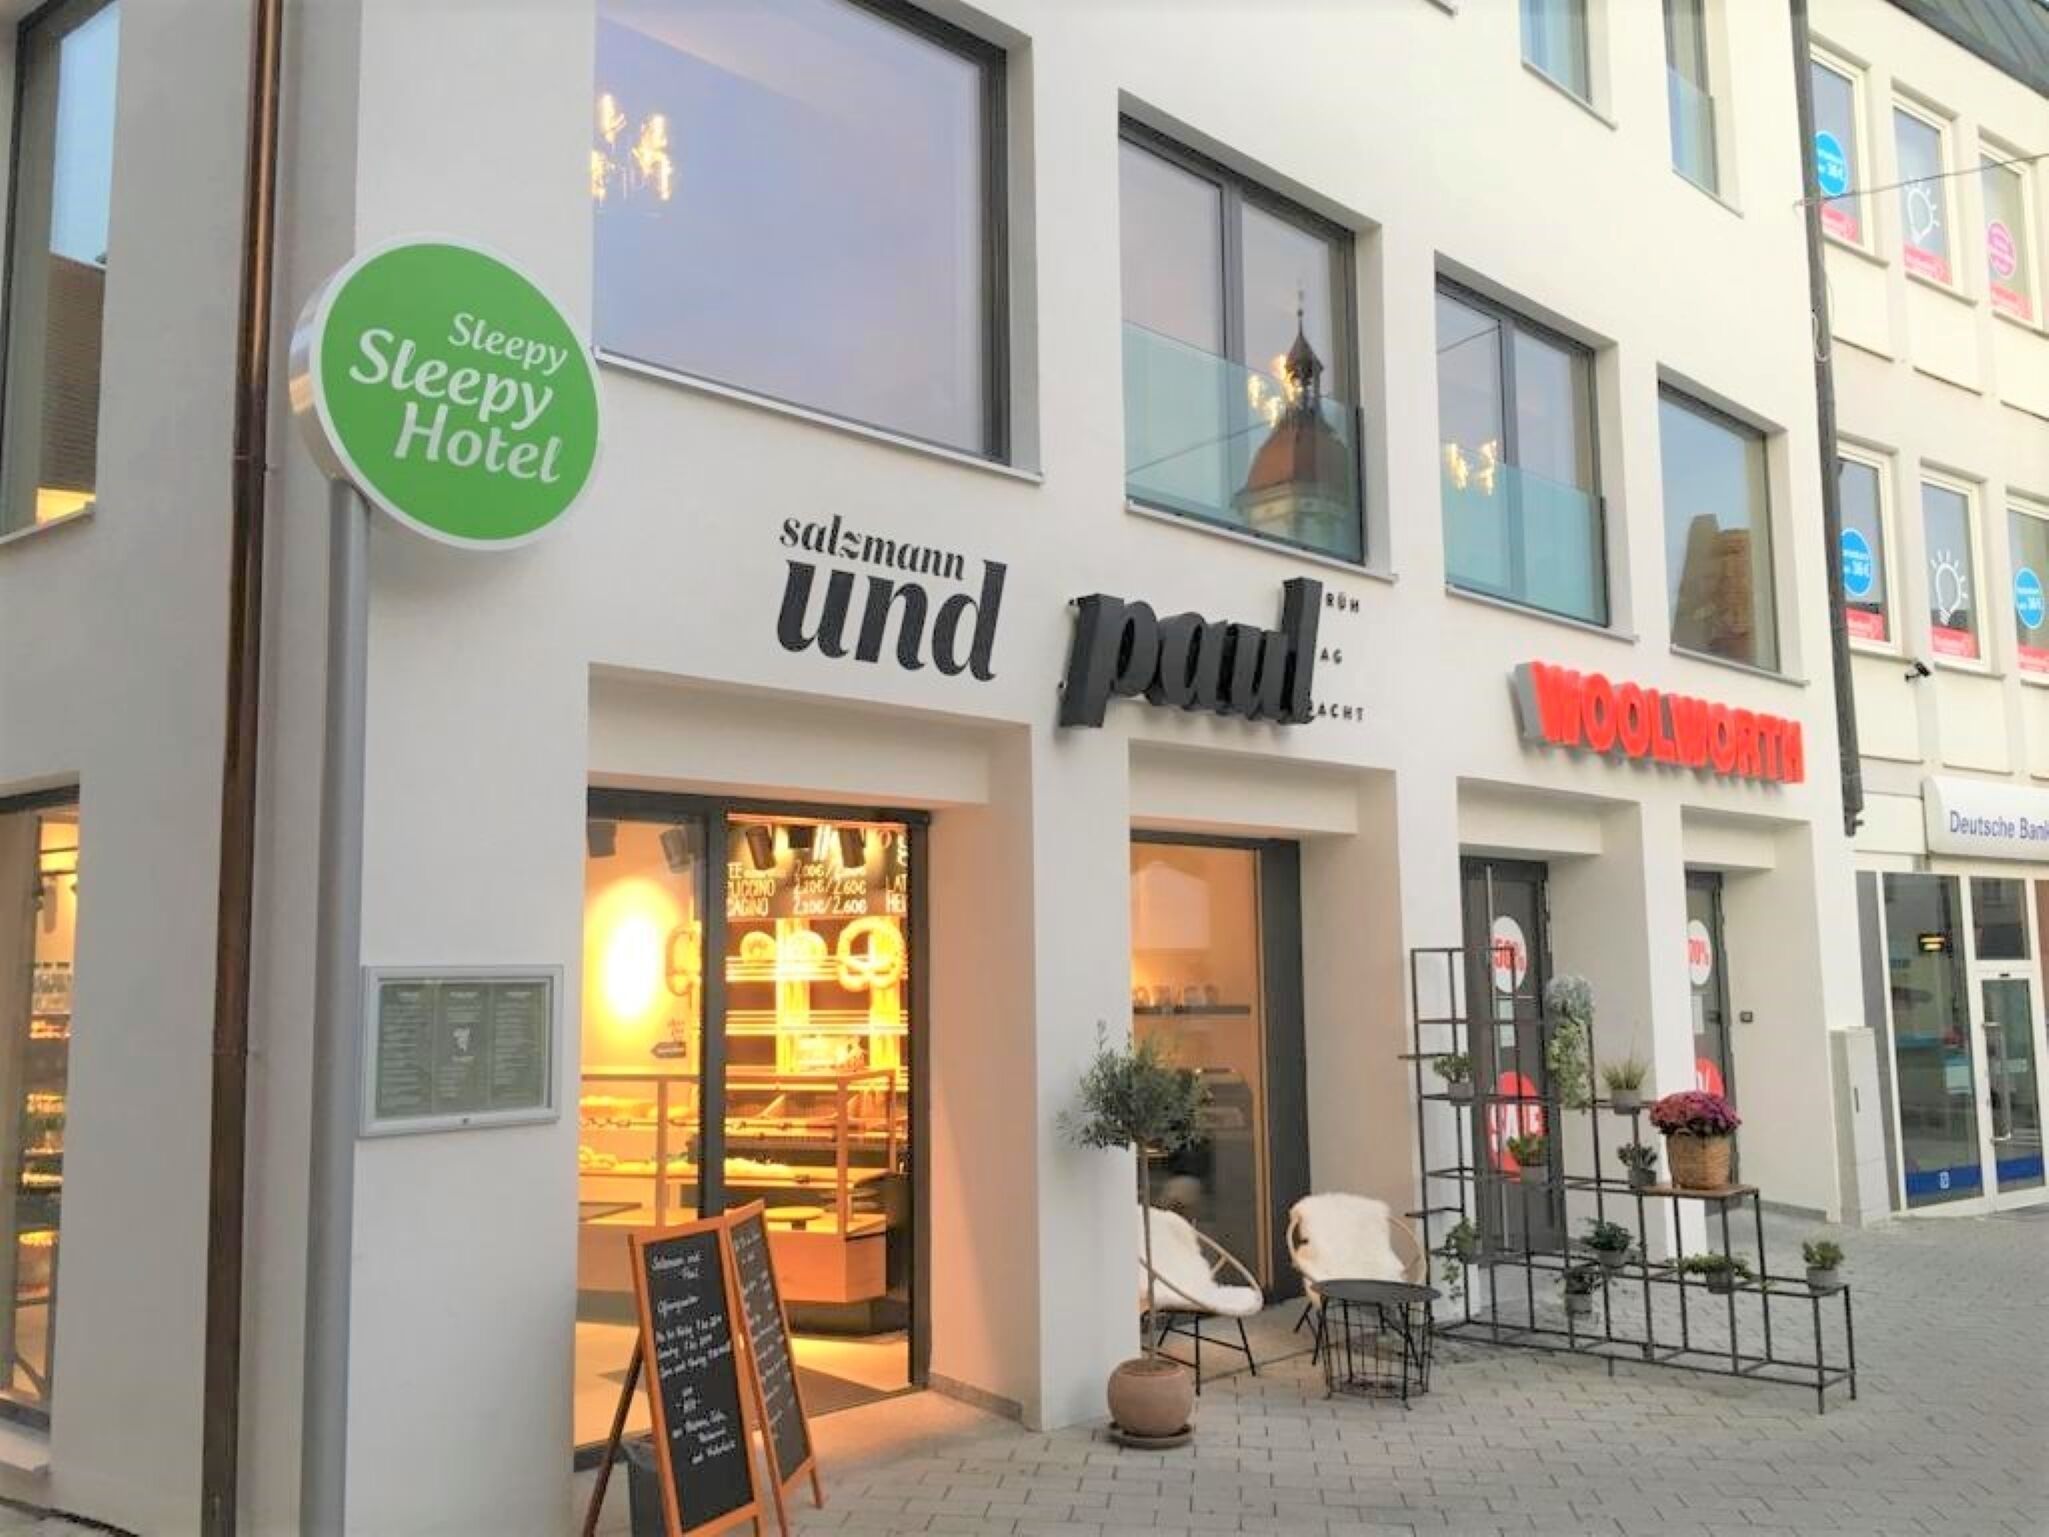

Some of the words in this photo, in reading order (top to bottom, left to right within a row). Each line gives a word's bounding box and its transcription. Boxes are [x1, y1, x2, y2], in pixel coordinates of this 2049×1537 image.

[349, 328, 554, 431] Sleepy
[448, 312, 569, 377] Sleepy
[393, 401, 563, 484] Hotel
[779, 513, 965, 581] salzmann
[776, 558, 1008, 683] und
[1059, 577, 1322, 727] paul
[1522, 660, 1805, 785] WOOLWORTH
[1949, 809, 2015, 839] Deutsche
